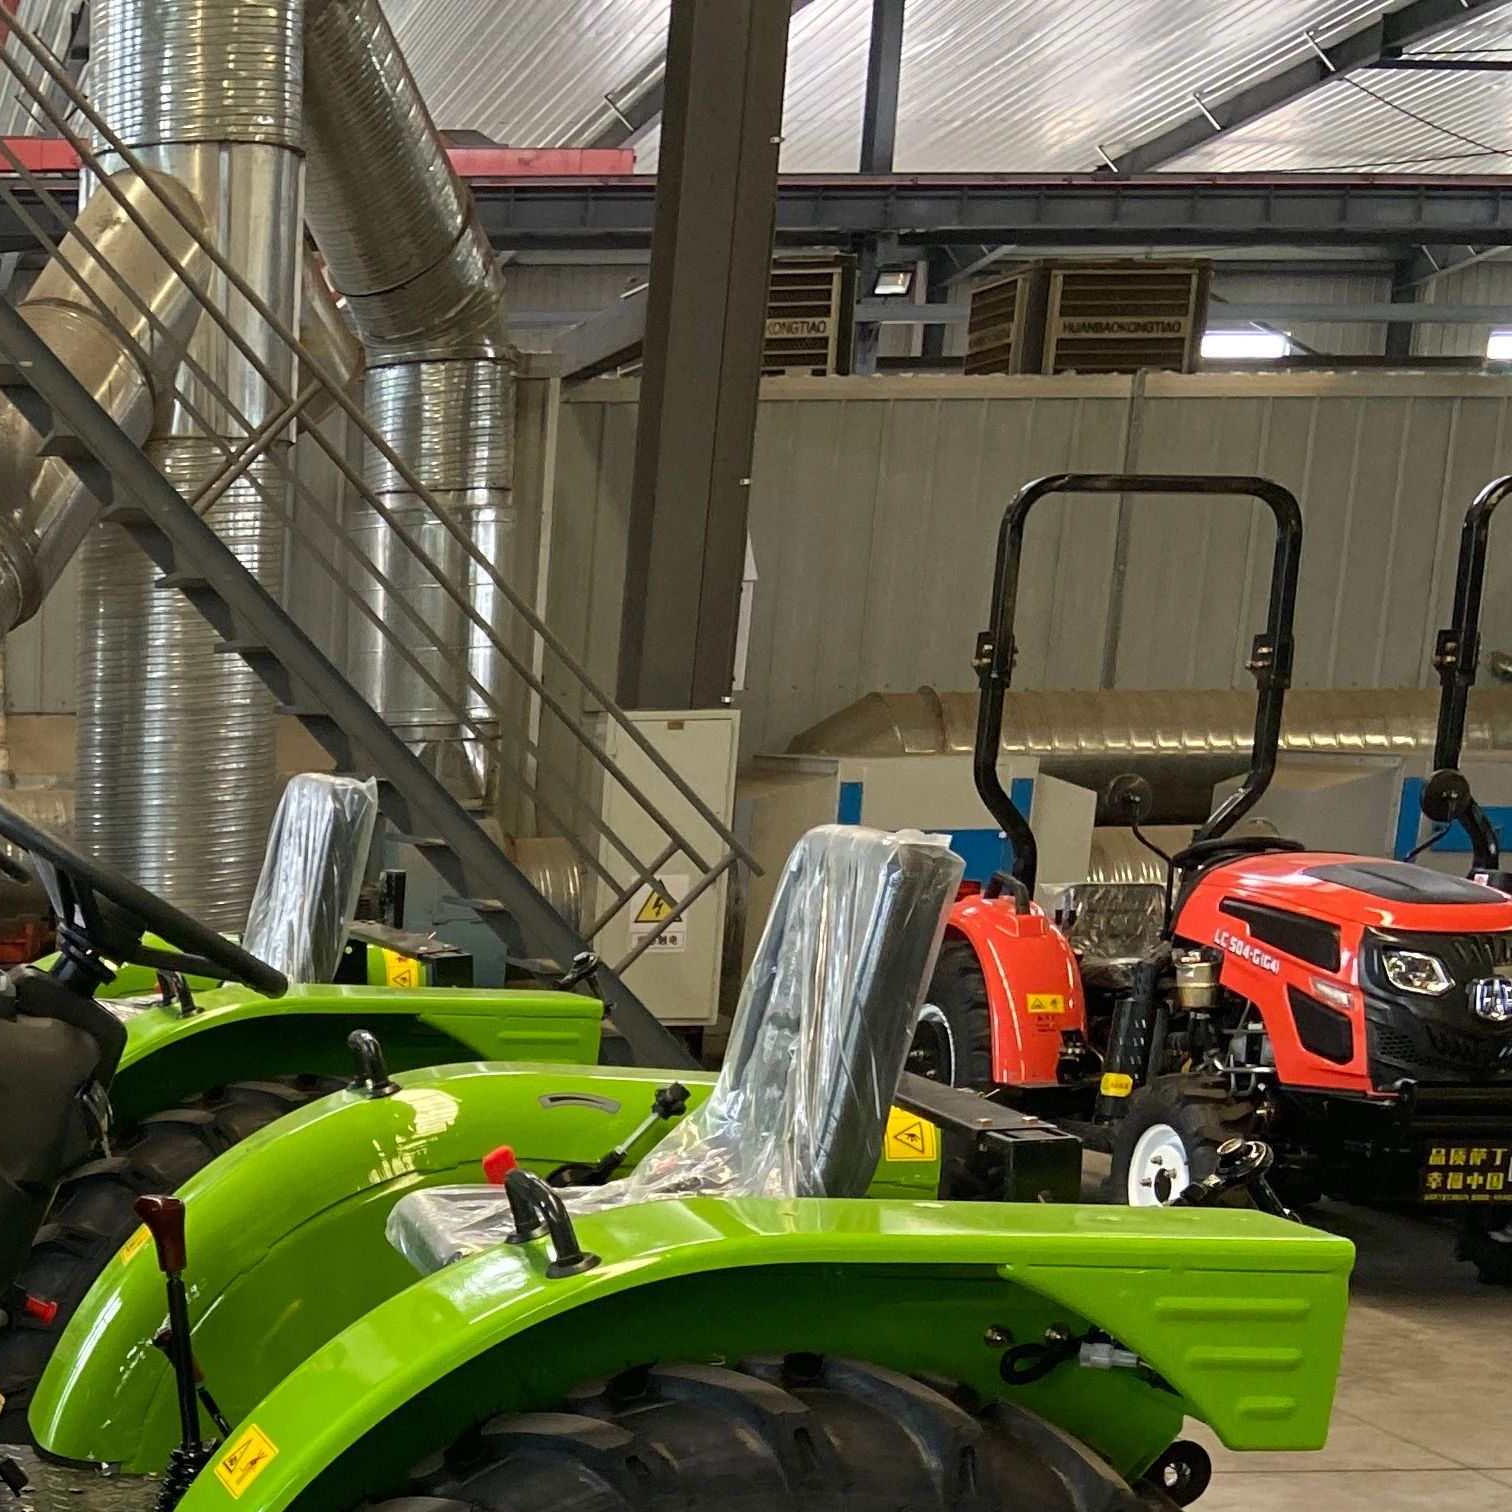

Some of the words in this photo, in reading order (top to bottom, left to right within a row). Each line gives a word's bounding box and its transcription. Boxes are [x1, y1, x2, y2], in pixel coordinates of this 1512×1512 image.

[1214, 927, 1230, 948] LC
[1425, 1171, 1505, 1190] 幸福中国
